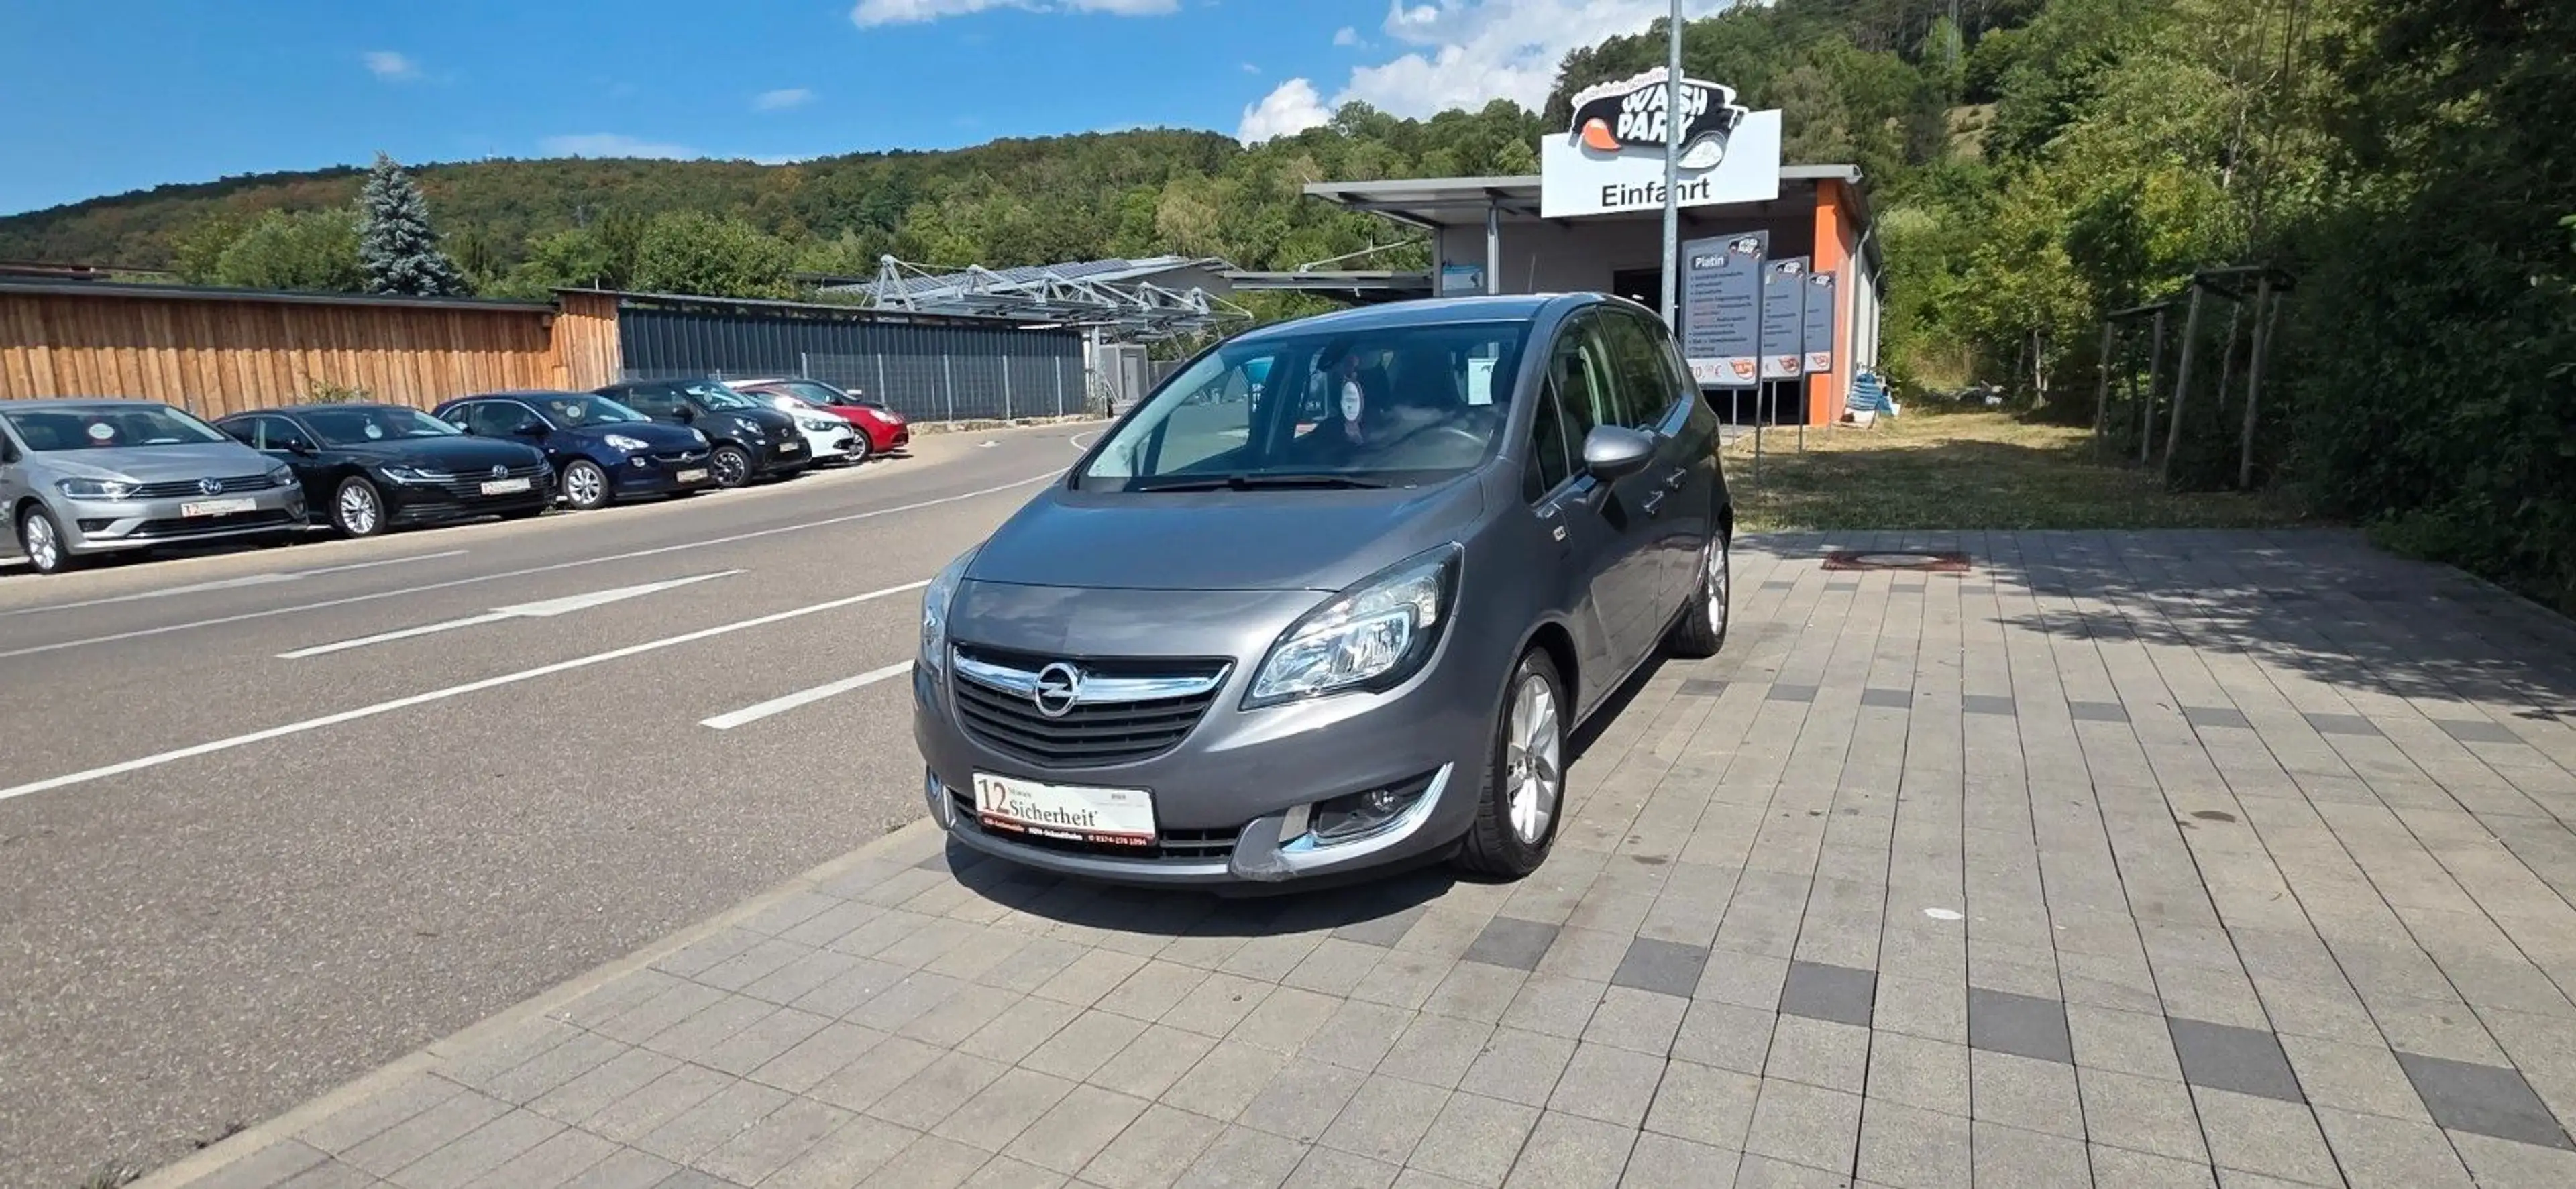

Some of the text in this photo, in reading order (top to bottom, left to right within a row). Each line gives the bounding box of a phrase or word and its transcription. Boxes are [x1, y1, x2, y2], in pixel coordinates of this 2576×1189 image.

[1695, 254, 1725, 268] Platin
[977, 779, 1010, 814] 12
[1009, 799, 1096, 826] Sicherheit
